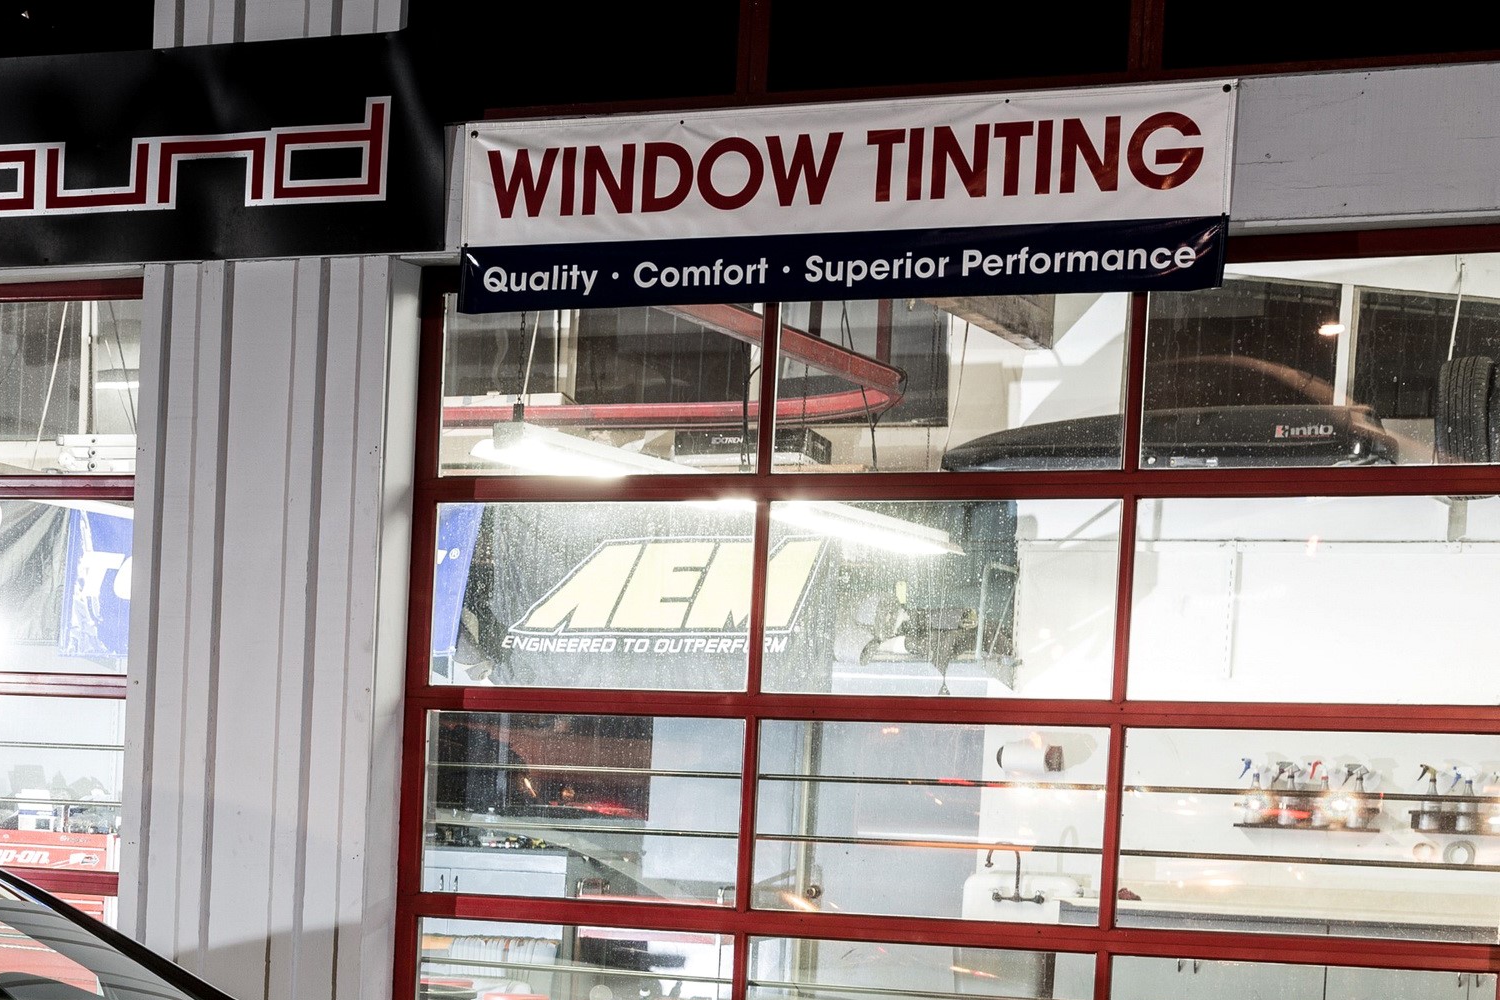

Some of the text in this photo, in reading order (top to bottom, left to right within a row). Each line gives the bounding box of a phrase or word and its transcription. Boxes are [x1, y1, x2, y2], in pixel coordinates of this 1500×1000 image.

[487, 111, 1205, 219] WINDOW TINTING
[483, 242, 1197, 296] Quality Comfort Superior Performance
[501, 635, 617, 654] ENGINEERED
[624, 637, 650, 653] TO
